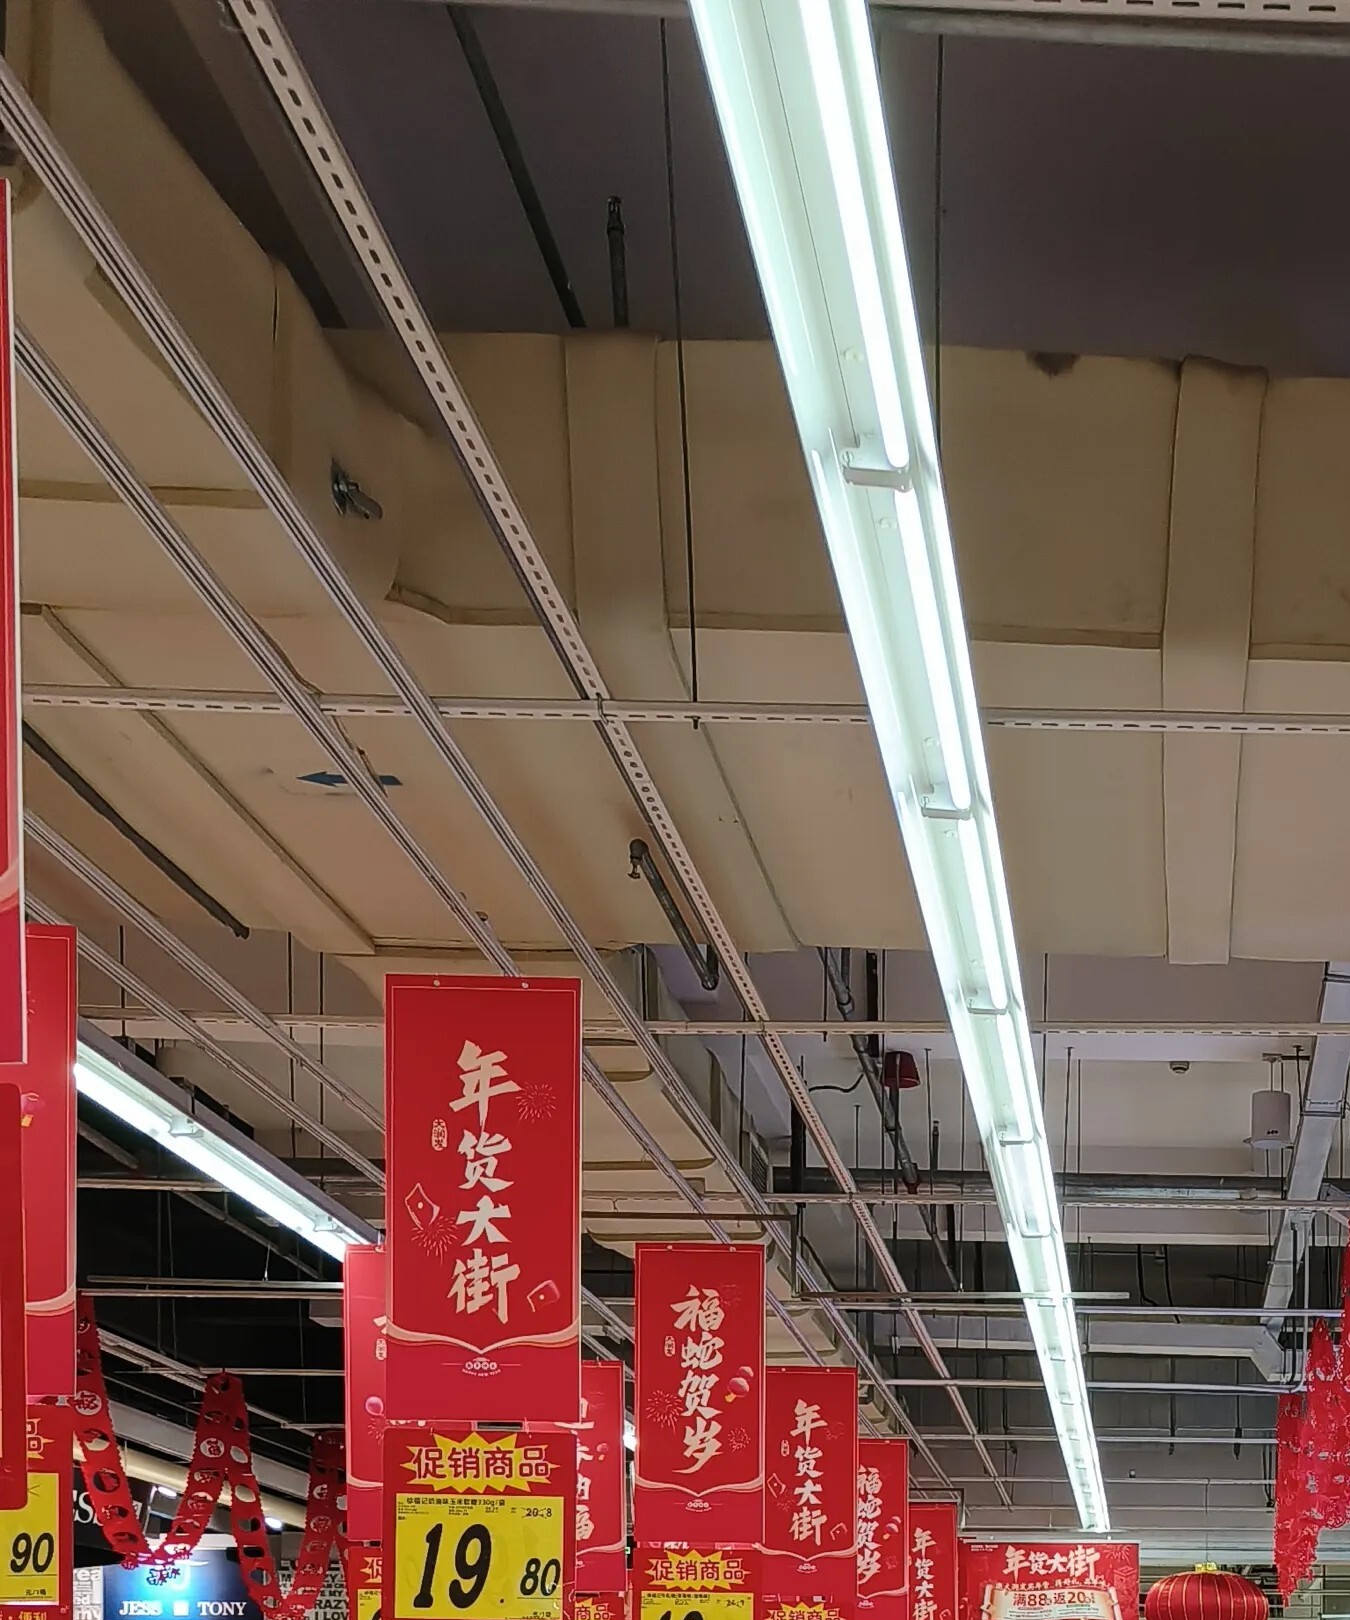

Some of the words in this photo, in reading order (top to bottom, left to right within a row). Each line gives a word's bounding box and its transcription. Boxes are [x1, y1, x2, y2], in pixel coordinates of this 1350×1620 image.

[448, 1040, 523, 1324] 年货大街
[671, 1285, 725, 1475] 福蛇贺岁
[413, 1447, 549, 1479] 促销商品
[788, 1400, 828, 1546] 年货大街
[10, 1532, 54, 1574] 90
[653, 1559, 744, 1581] 促销商品
[1003, 1545, 1101, 1582] 年货大街
[119, 1602, 162, 1616] JESS
[198, 1602, 247, 1617] TONY
